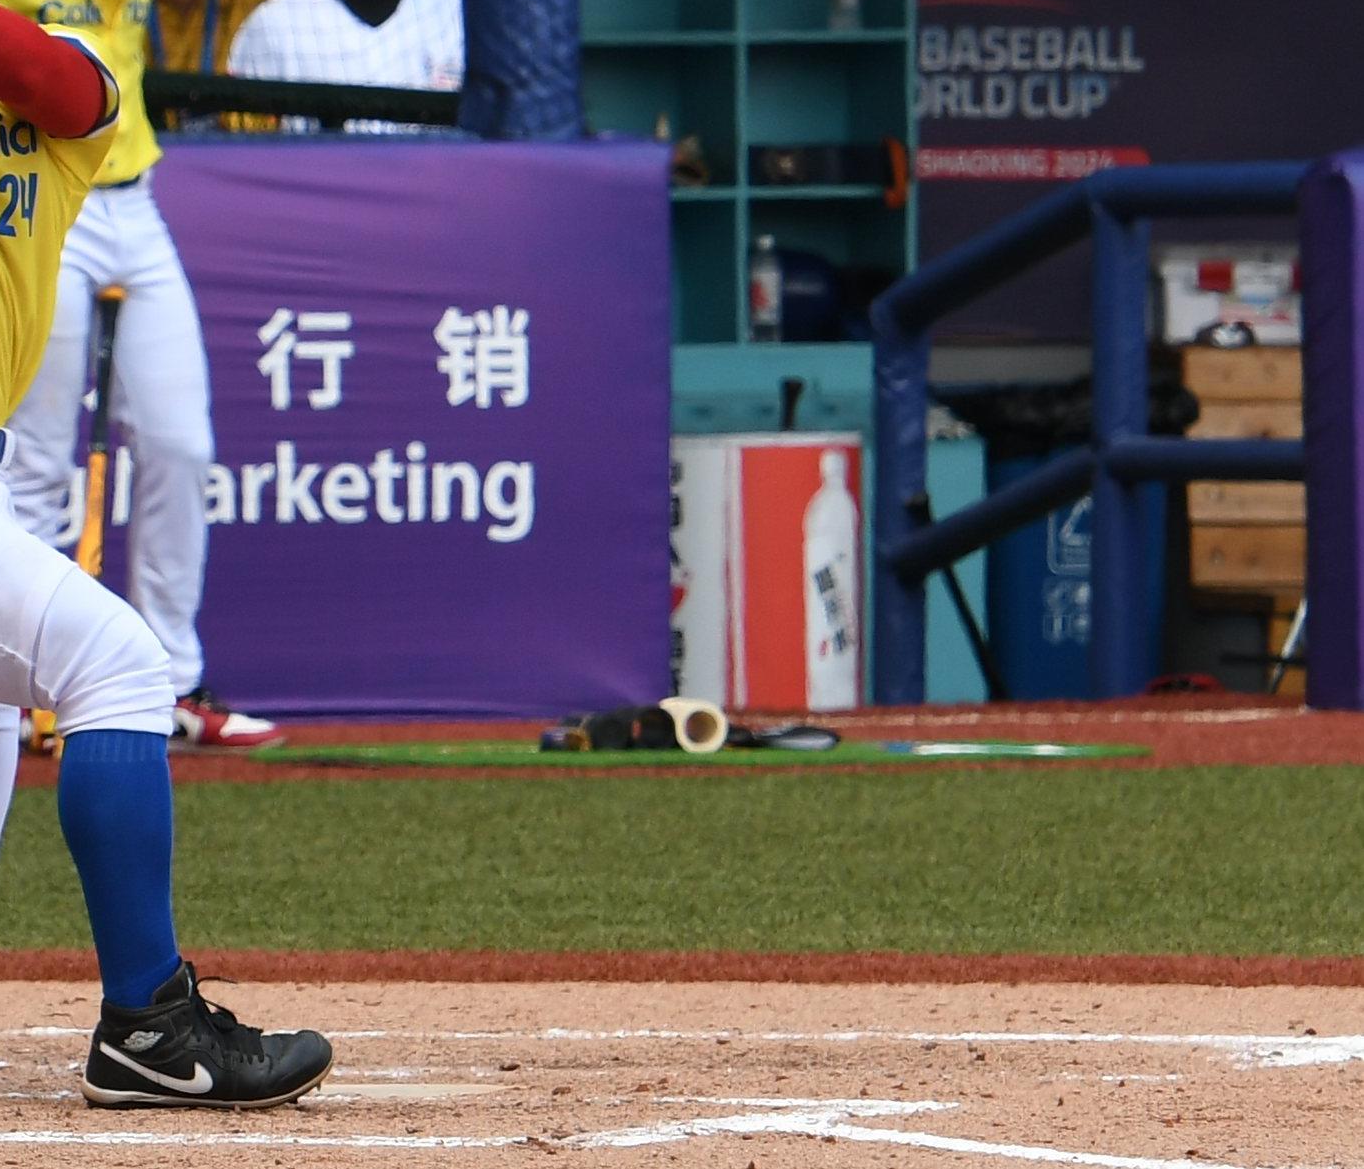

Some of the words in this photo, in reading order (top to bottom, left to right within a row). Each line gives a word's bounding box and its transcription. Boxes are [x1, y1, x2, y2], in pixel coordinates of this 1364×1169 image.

[919, 25, 1145, 73] BASEBALL
[1020, 75, 1107, 119] CUP
[111, 439, 534, 544] arketing
